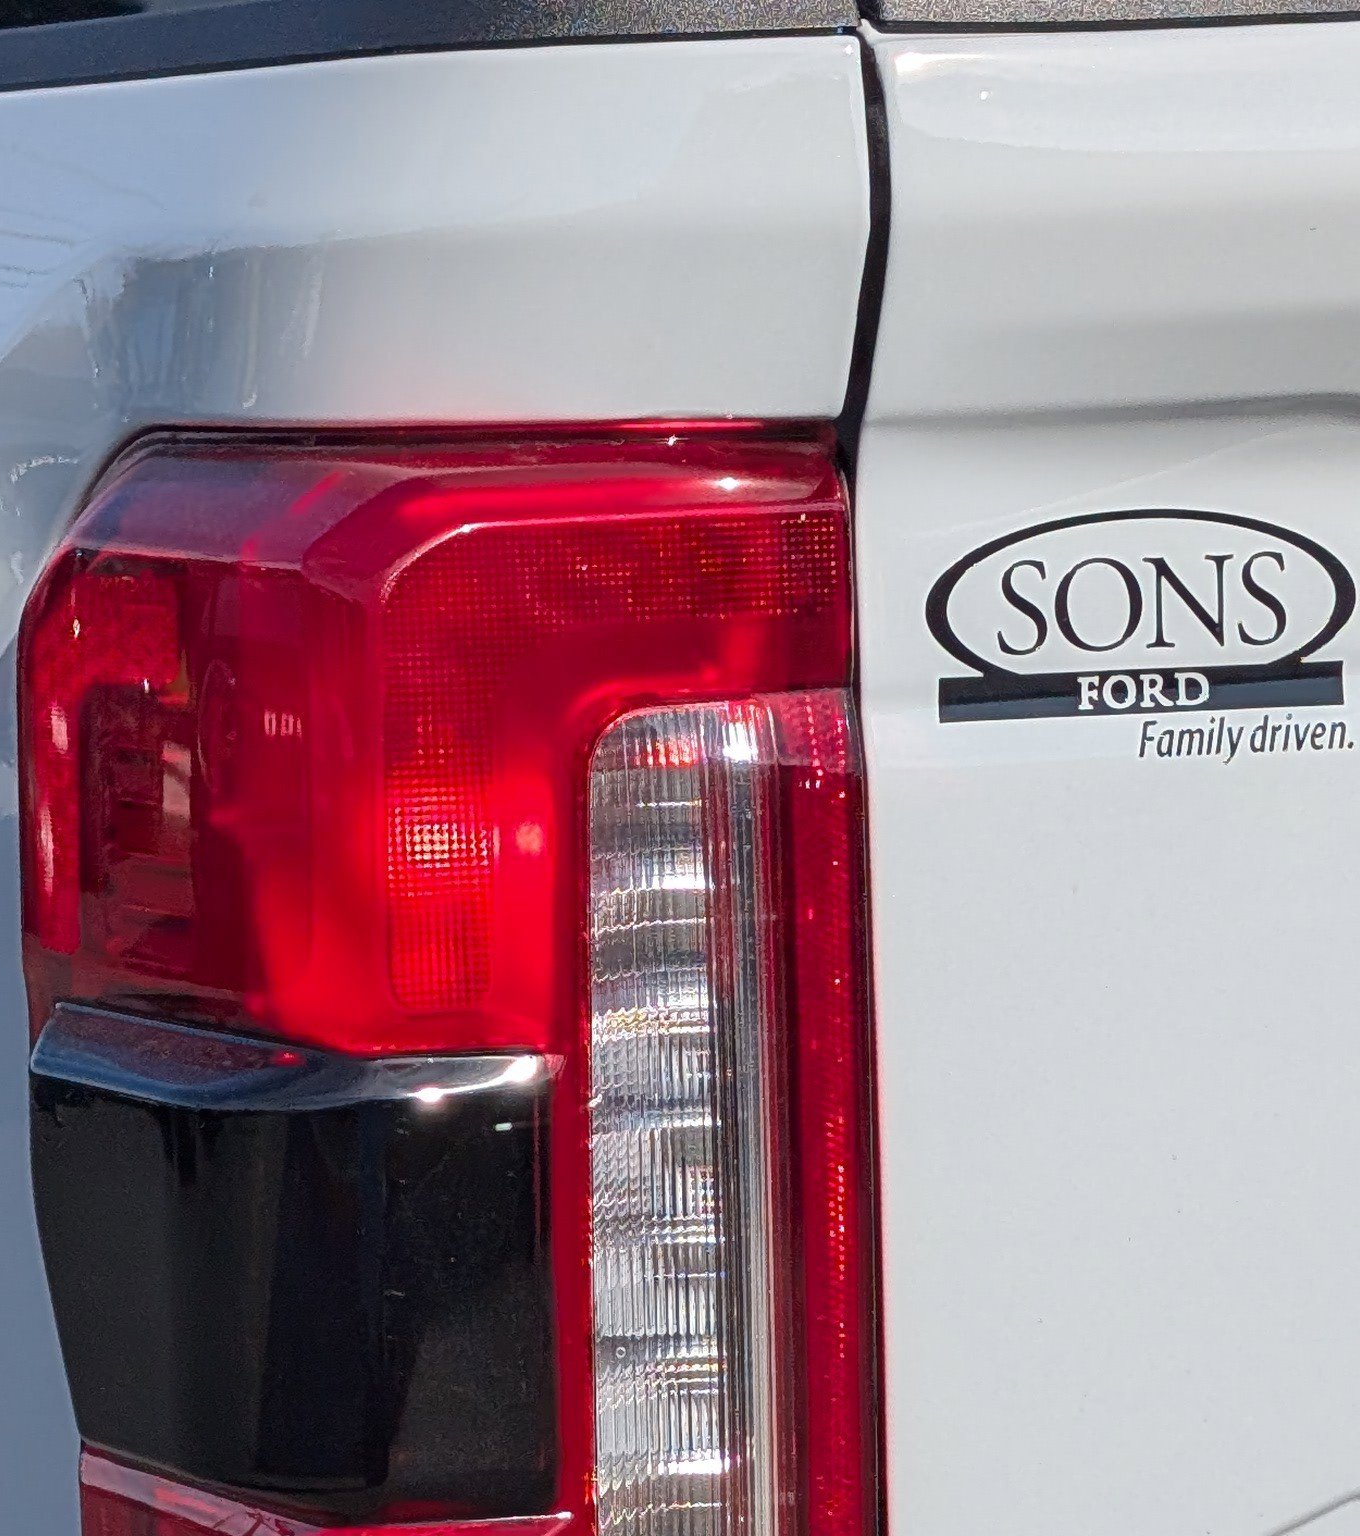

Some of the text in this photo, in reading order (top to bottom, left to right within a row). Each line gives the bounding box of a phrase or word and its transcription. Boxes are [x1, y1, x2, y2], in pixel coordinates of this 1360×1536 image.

[996, 550, 1288, 656] SONS
[1077, 671, 1210, 711] FORD
[1139, 712, 1356, 765] Family driven.
